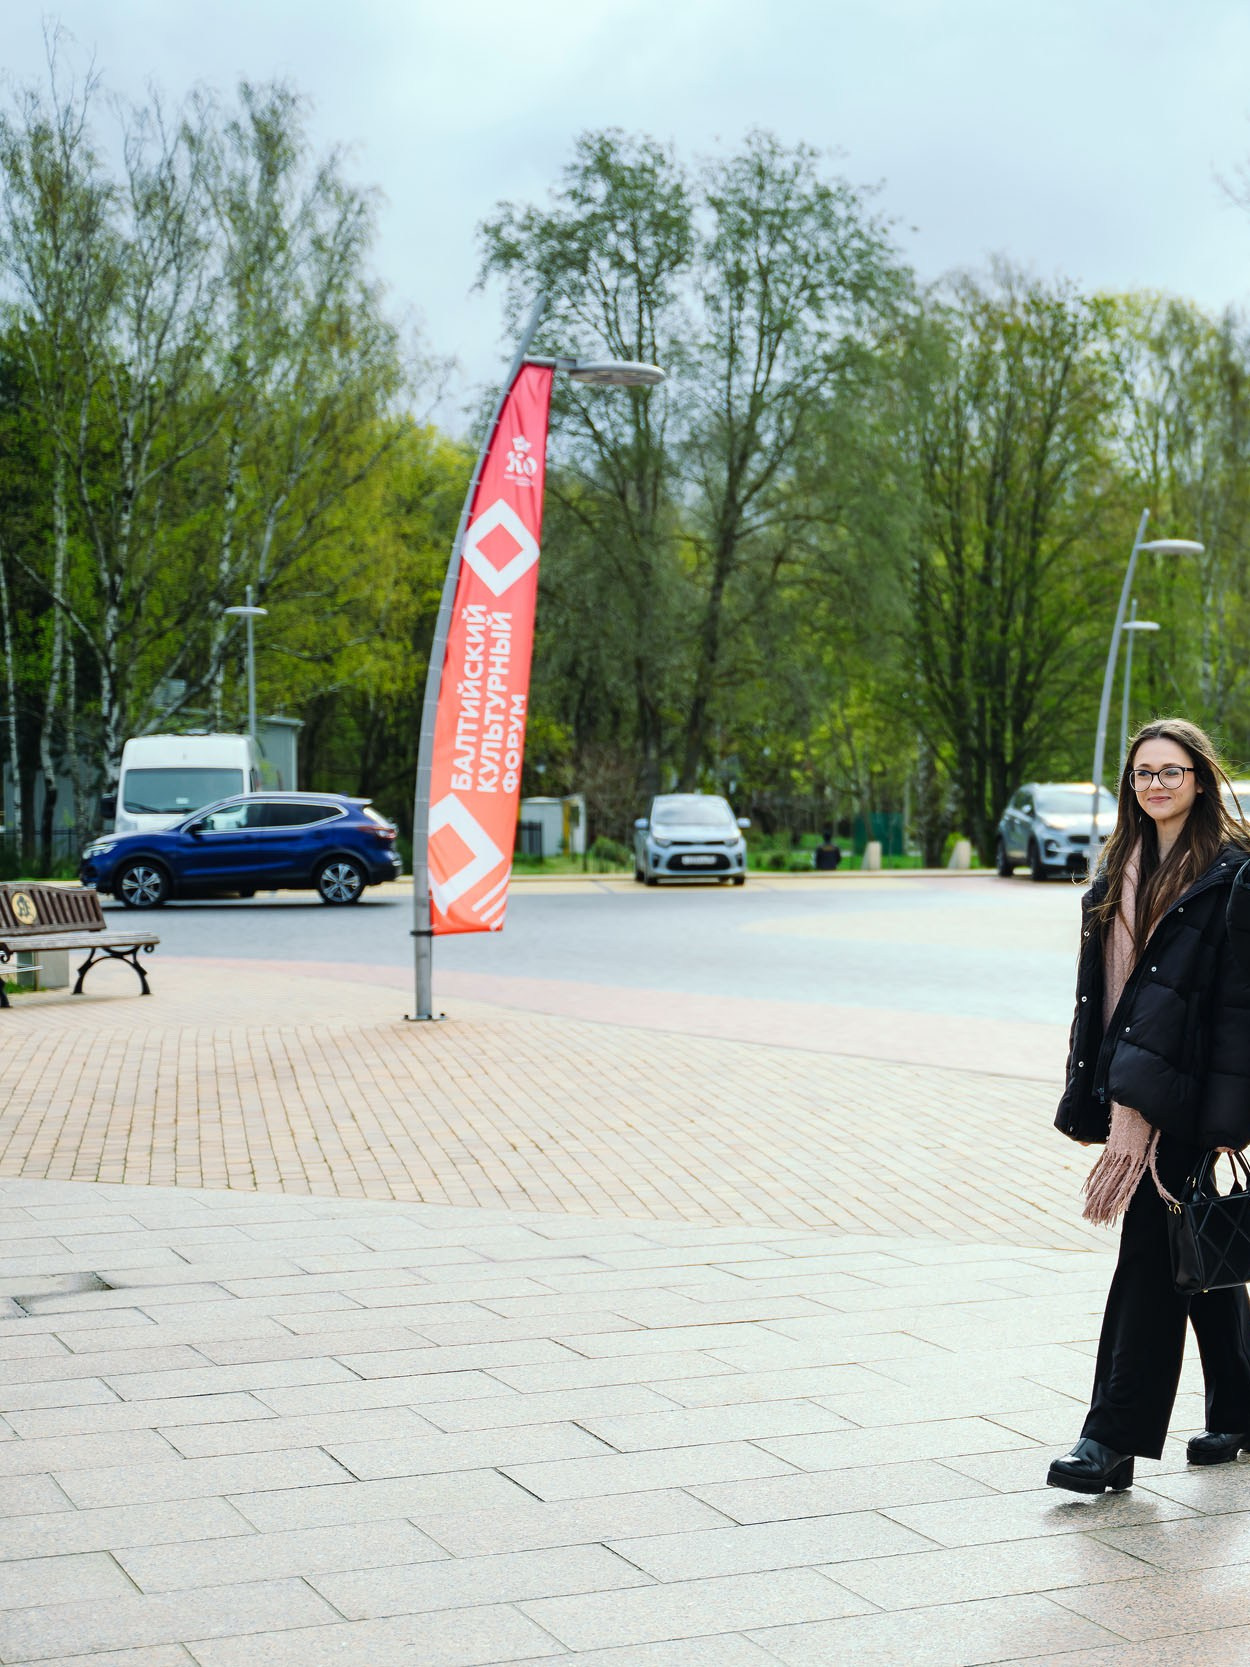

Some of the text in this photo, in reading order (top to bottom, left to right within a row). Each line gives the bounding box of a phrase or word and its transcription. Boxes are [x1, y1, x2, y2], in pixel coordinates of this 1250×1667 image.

[451, 604, 488, 790] БАЛТИЙСКИЙ
[476, 611, 513, 793] КУЛЬТУРНЫЙ
[502, 694, 526, 793] ФОРУМ
